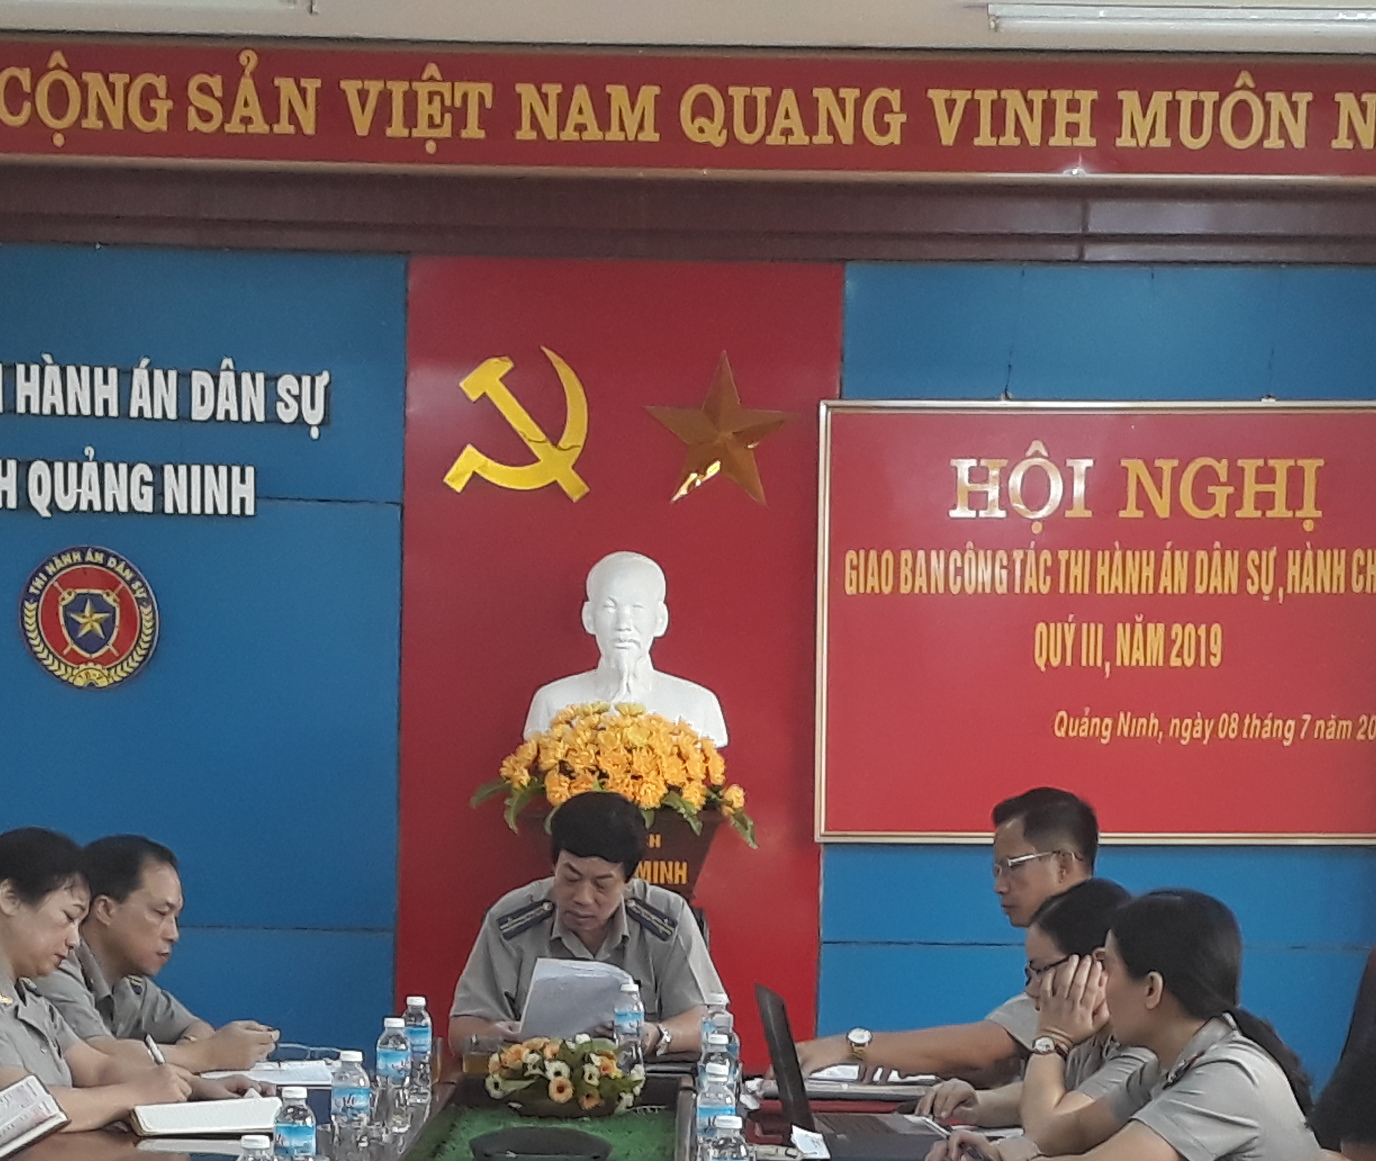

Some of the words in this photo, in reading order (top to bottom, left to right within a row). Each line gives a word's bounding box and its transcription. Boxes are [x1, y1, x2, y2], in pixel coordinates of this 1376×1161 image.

[187, 50, 322, 136] SẢN
[340, 63, 493, 154] VIỆT
[515, 83, 661, 142] NAM
[679, 83, 907, 146] QUANG
[927, 88, 1099, 148] VINH
[1115, 71, 1313, 150] MUÔN
[16, 353, 119, 417] HÀNH
[129, 357, 177, 420] ÁN
[191, 357, 266, 422] DÂN
[276, 370, 330, 440] SỰ
[28, 446, 154, 517] QUẢNG
[164, 464, 255, 516] NINH
[948, 440, 1095, 535] HỘI
[1118, 456, 1325, 532] NGHỊ
[29, 573, 48, 596] THI
[844, 549, 895, 595] GIAO
[899, 549, 946, 595] BAN
[948, 540, 1009, 595] CÔNG
[1011, 540, 1053, 595] TÁC
[1057, 549, 1091, 595] THI
[1096, 540, 1156, 595] HÀNH
[1158, 540, 1189, 595] ÁN
[1194, 540, 1240, 595] DÂN
[1287, 541, 1346, 594] HÀNH
[1034, 613, 1077, 672] QUÝ
[1080, 622, 1112, 679] III,
[1115, 613, 1165, 667] NĂM
[1169, 622, 1224, 668] 2019
[1053, 706, 1113, 745] Quảng
[1116, 710, 1164, 744] Ninh,
[1168, 711, 1215, 746] ngày
[1217, 712, 1240, 740] 08
[1242, 712, 1296, 747] tháng
[1299, 713, 1312, 740] 7
[1313, 713, 1353, 740] năm
[634, 860, 689, 885] MINH
